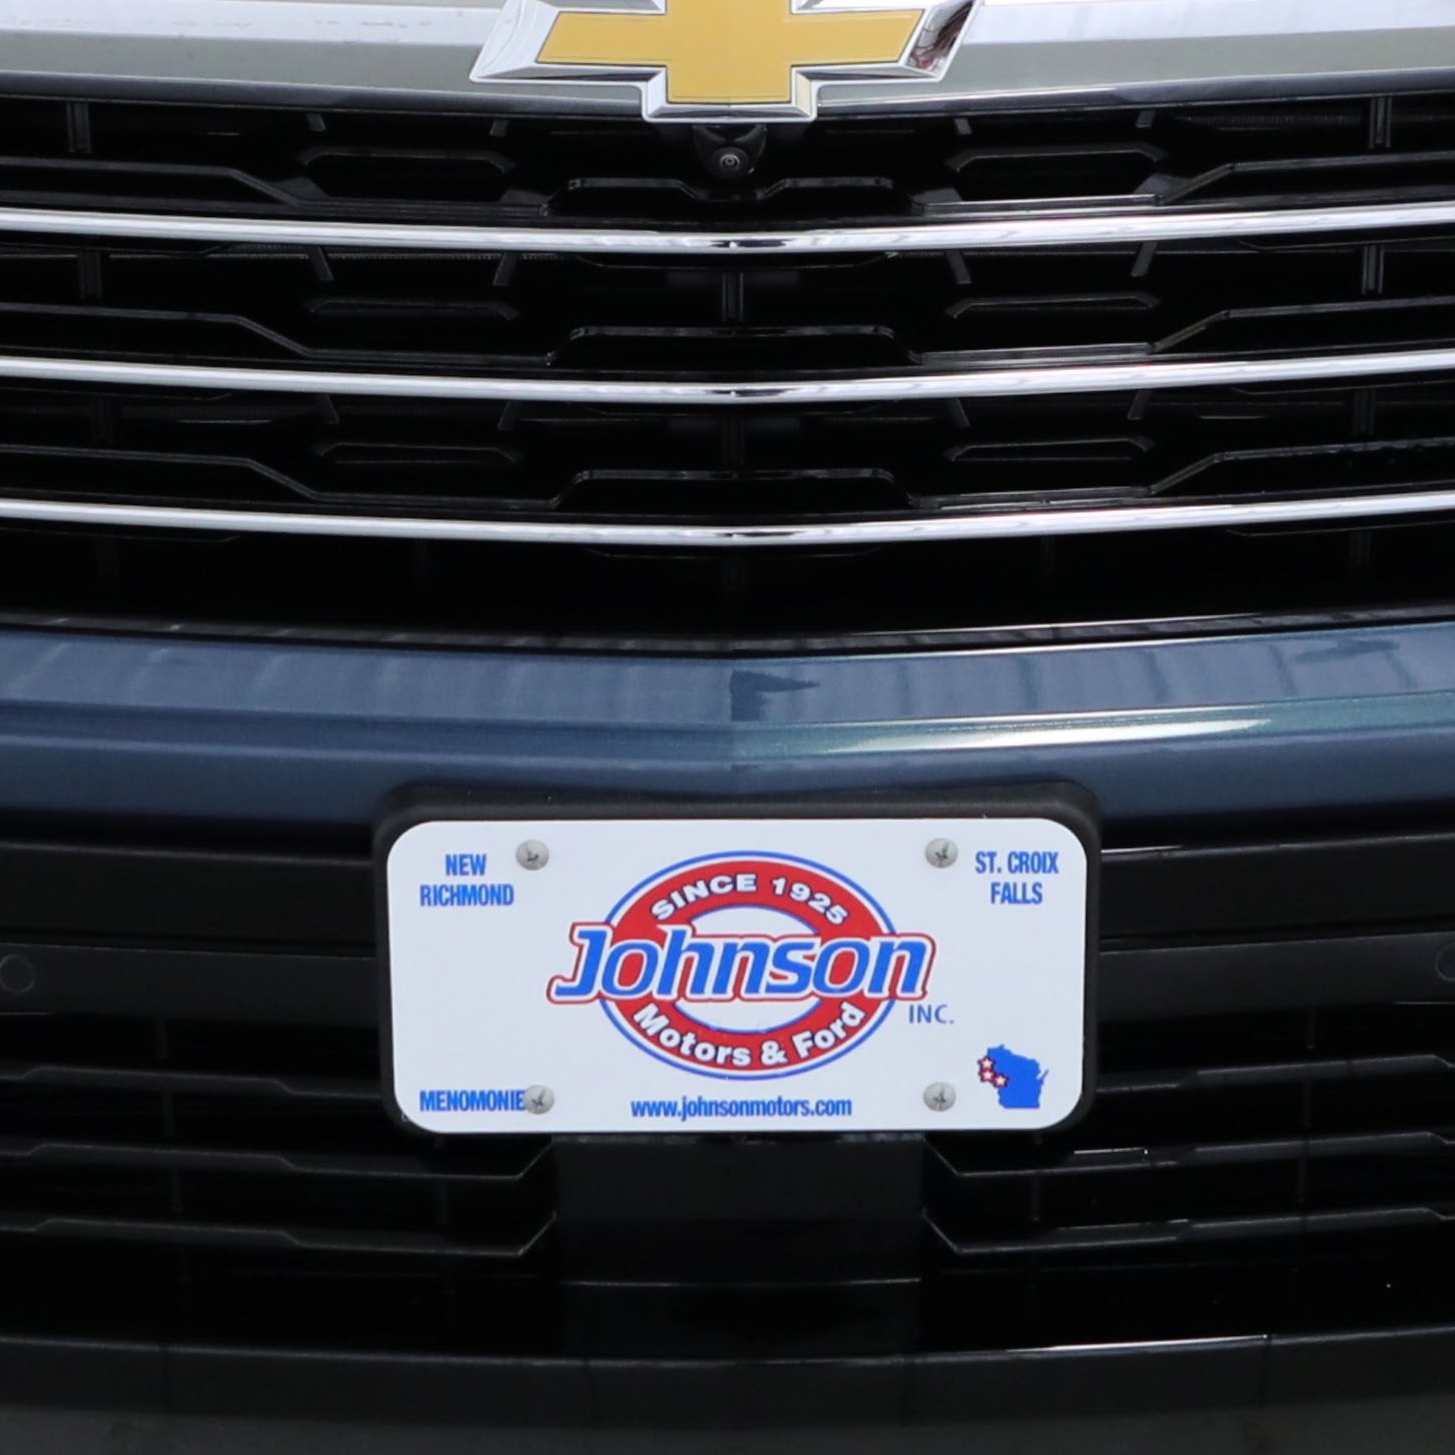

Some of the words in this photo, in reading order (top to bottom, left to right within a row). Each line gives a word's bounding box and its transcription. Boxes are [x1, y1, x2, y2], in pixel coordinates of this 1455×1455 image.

[445, 853, 487, 877] NEW
[975, 850, 1002, 874] ST.
[1007, 850, 1059, 874] CROIX
[419, 883, 515, 907] RICHMOND
[651, 873, 757, 921] SINCE
[771, 877, 849, 925] 1925
[990, 881, 1043, 905] FALLS
[551, 926, 929, 1001] Johnson
[908, 1004, 955, 1025] INC.
[632, 1002, 752, 1067] Motors
[760, 1040, 788, 1066] &
[791, 1001, 867, 1059] Ford
[419, 1089, 528, 1112] MENOMONIE
[630, 1095, 853, 1122] www.johnsonmotors.com
